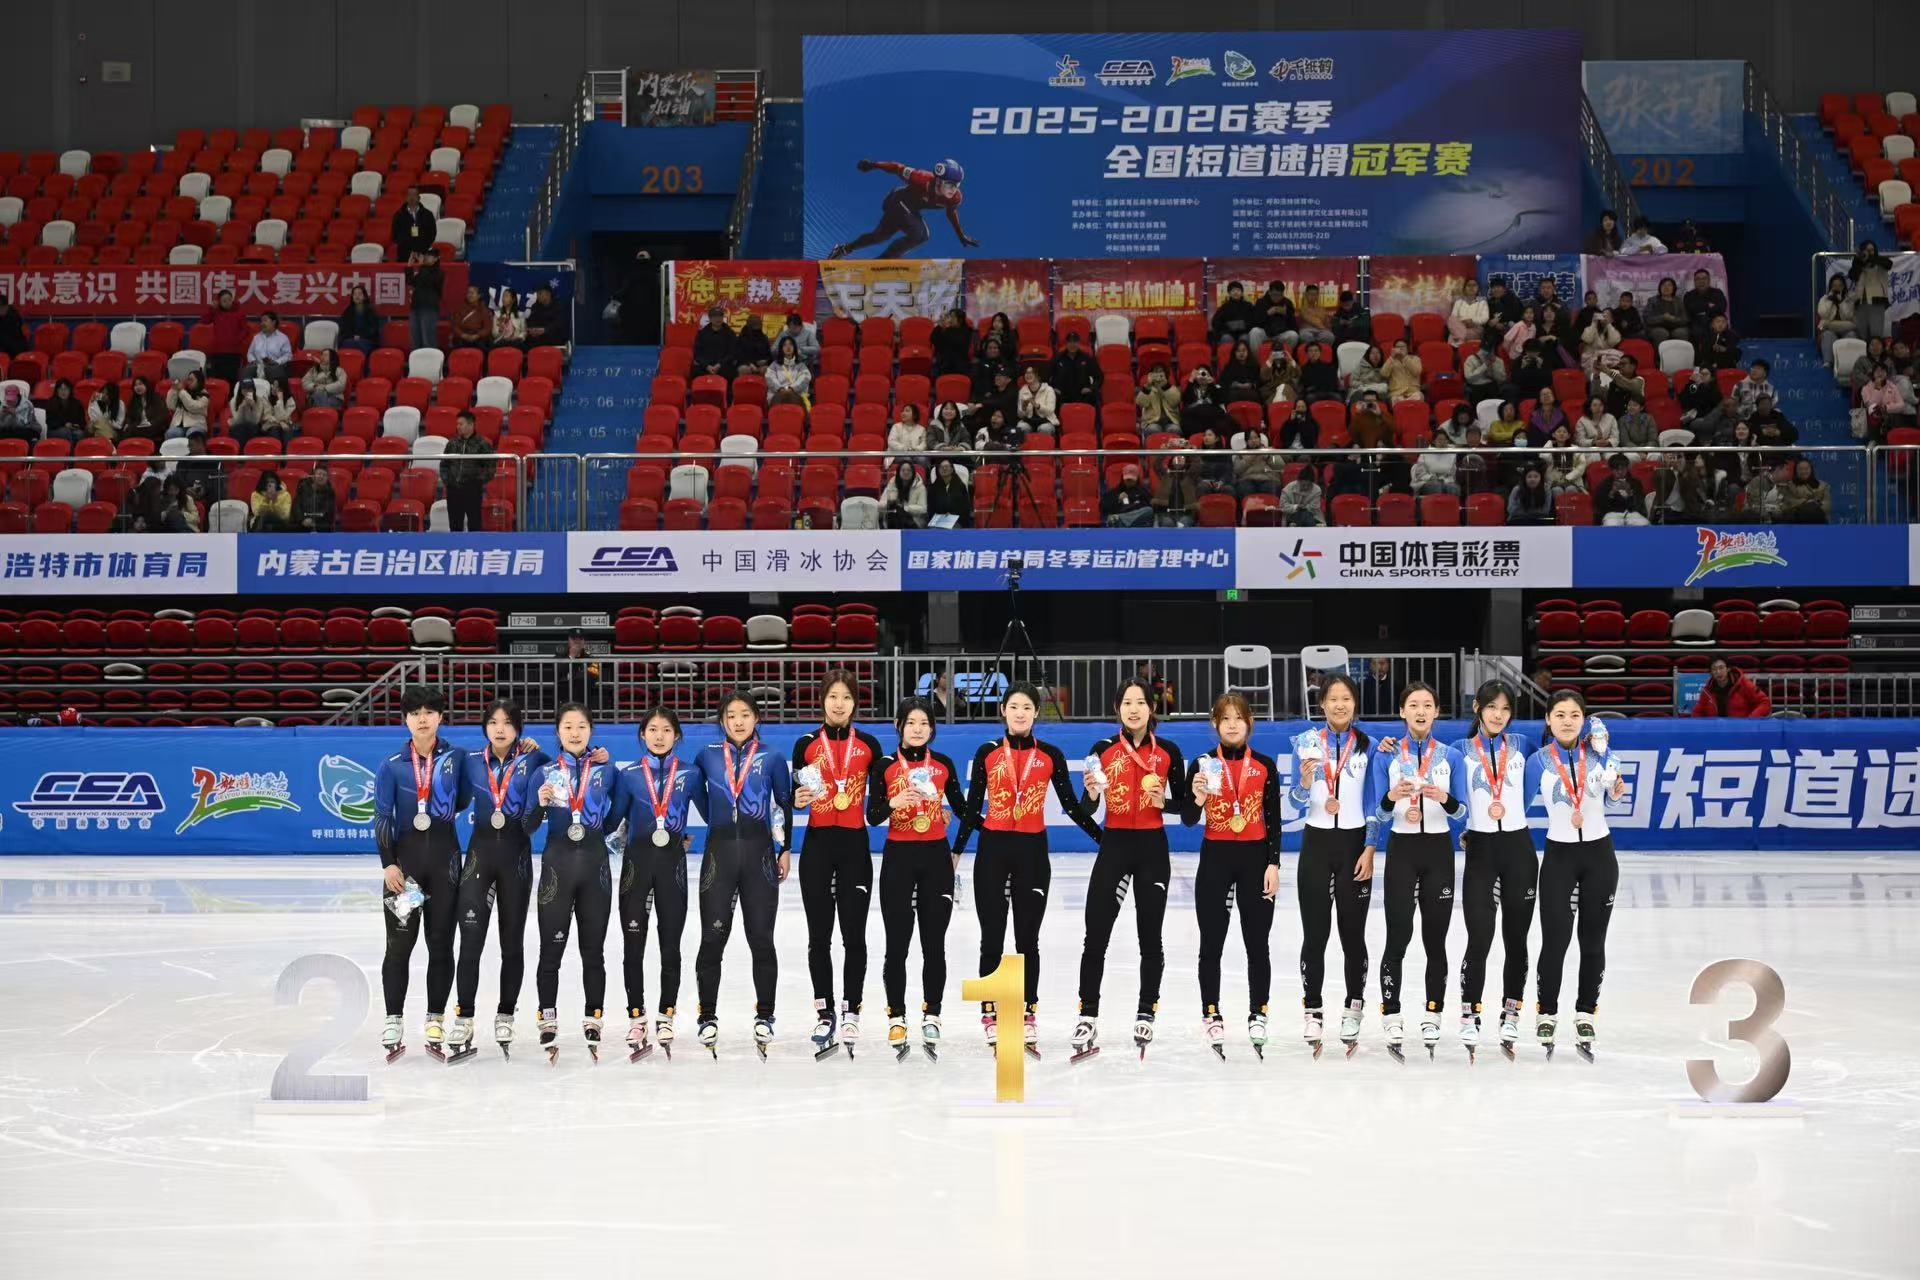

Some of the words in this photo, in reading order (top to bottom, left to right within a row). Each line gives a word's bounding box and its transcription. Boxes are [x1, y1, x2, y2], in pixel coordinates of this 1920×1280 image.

[970, 100, 1333, 134] 2025-2026赛季
[1104, 141, 1473, 178] 全国短道速滑冠军赛
[1631, 159, 1696, 186] 202
[641, 165, 703, 193] 203
[598, 397, 614, 408] 06
[589, 427, 606, 438] 05
[4, 552, 208, 578] 浩特市体育局
[257, 549, 544, 577] 内蒙古自治区体育局
[579, 547, 679, 572] CSA
[702, 549, 889, 573] 中国滑冰协会
[908, 549, 1229, 570] 国家体育总局冬季运动管理中心
[1339, 540, 1521, 568] 中国体育彩票
[1340, 569, 1385, 578] CHINA
[1389, 569, 1450, 578] SPORTS
[1456, 568, 1520, 578] LOTTERY
[13, 773, 165, 811] CSA
[270, 953, 371, 1100] 2
[962, 953, 1024, 1103] 1
[1686, 959, 1791, 1102] 3
